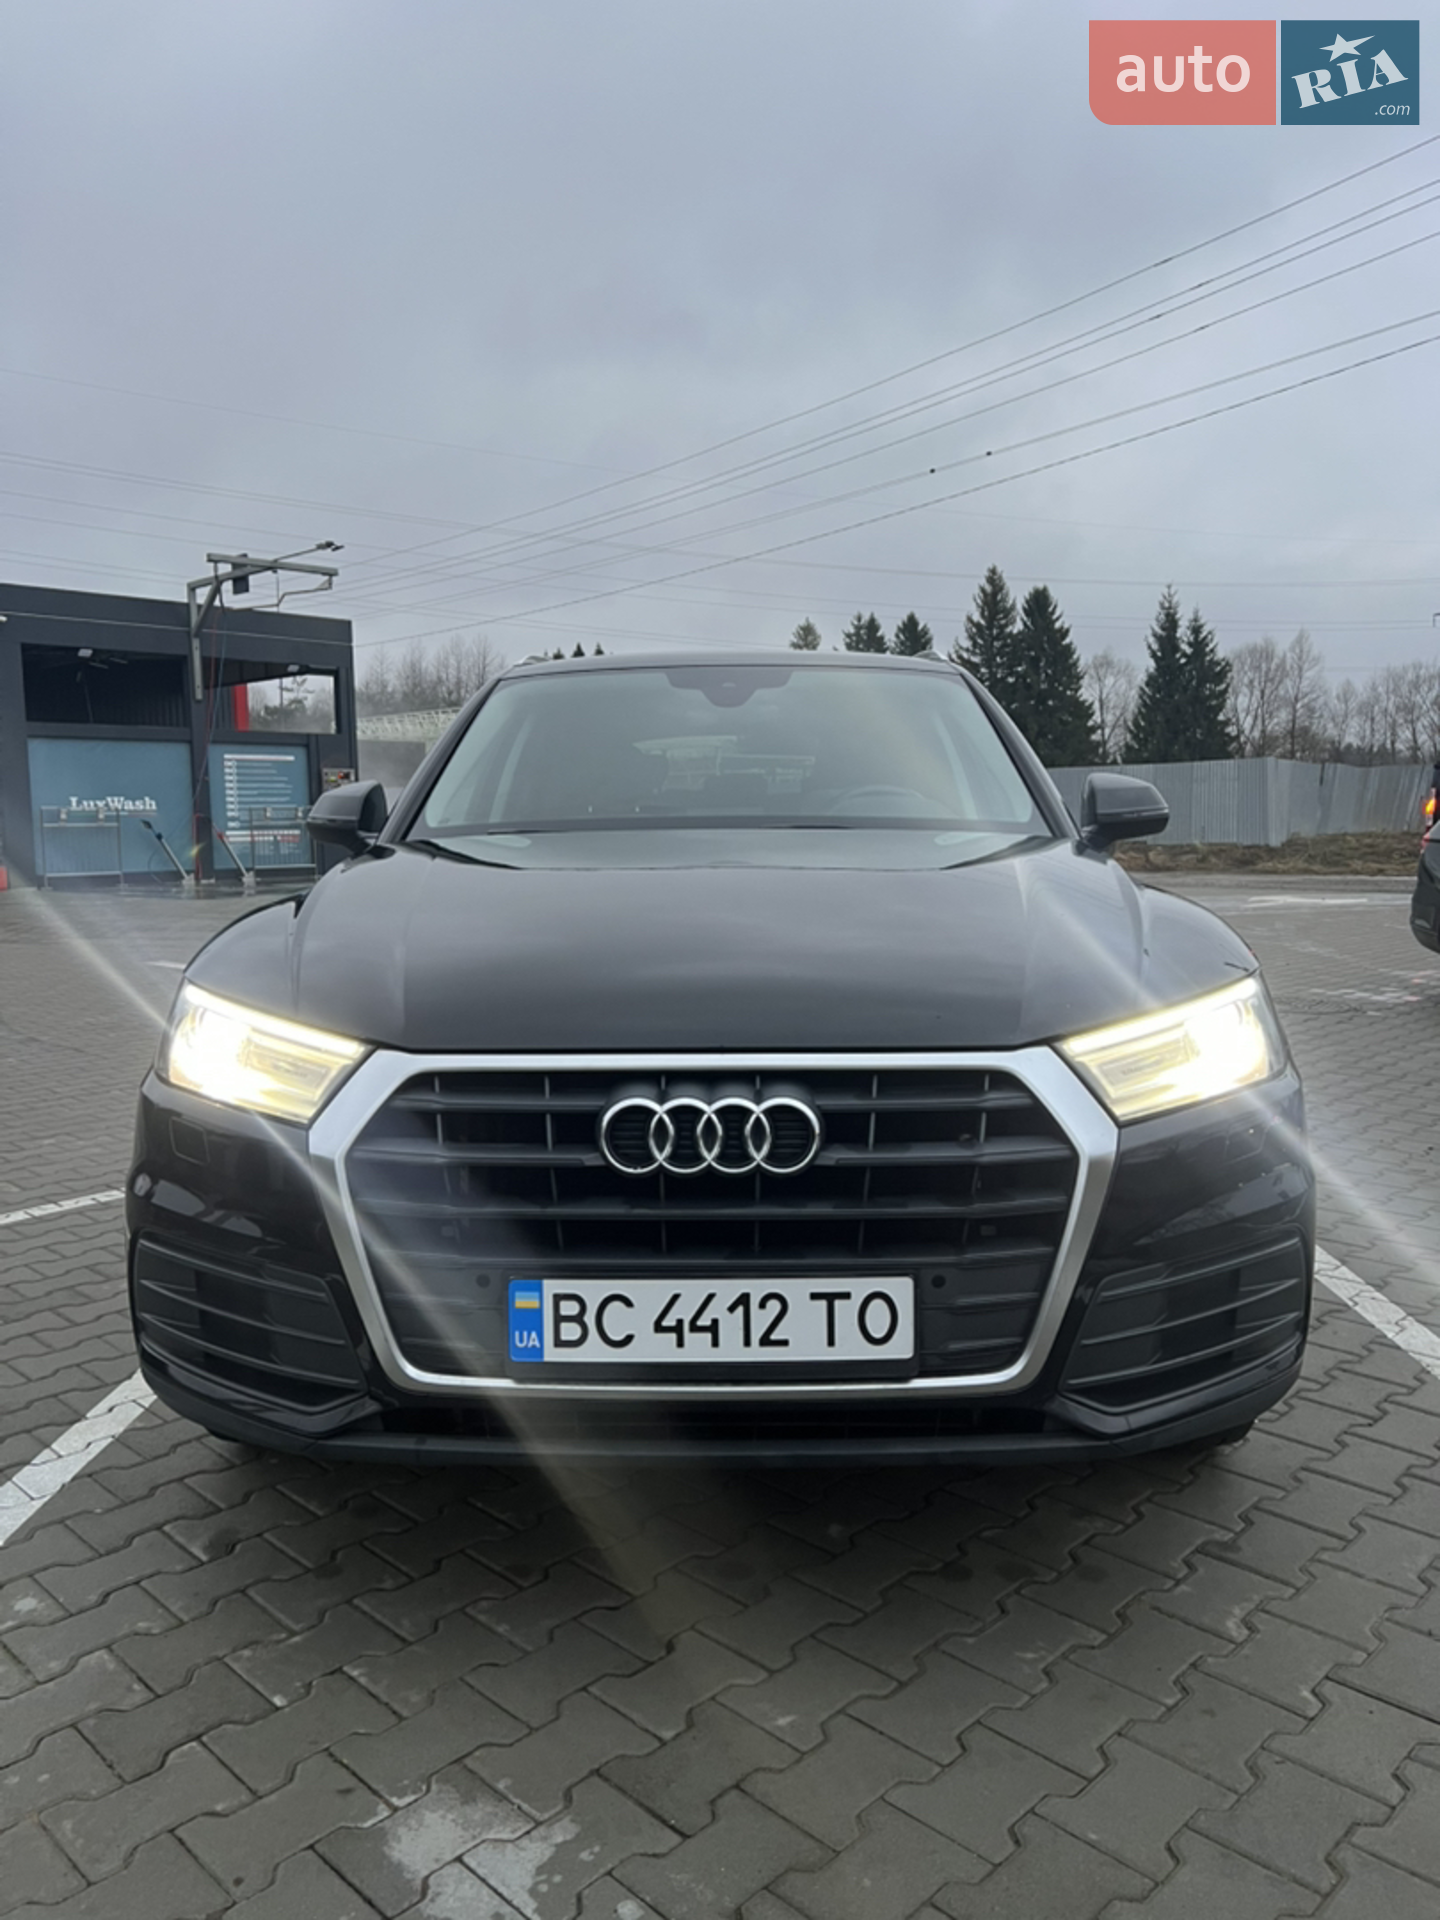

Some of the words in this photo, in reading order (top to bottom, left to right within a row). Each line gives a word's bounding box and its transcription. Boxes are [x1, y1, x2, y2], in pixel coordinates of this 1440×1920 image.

[552, 1292, 636, 1349] BC
[653, 1291, 790, 1349] 4412
[809, 1290, 900, 1348] TO
[514, 1330, 541, 1349] UA
